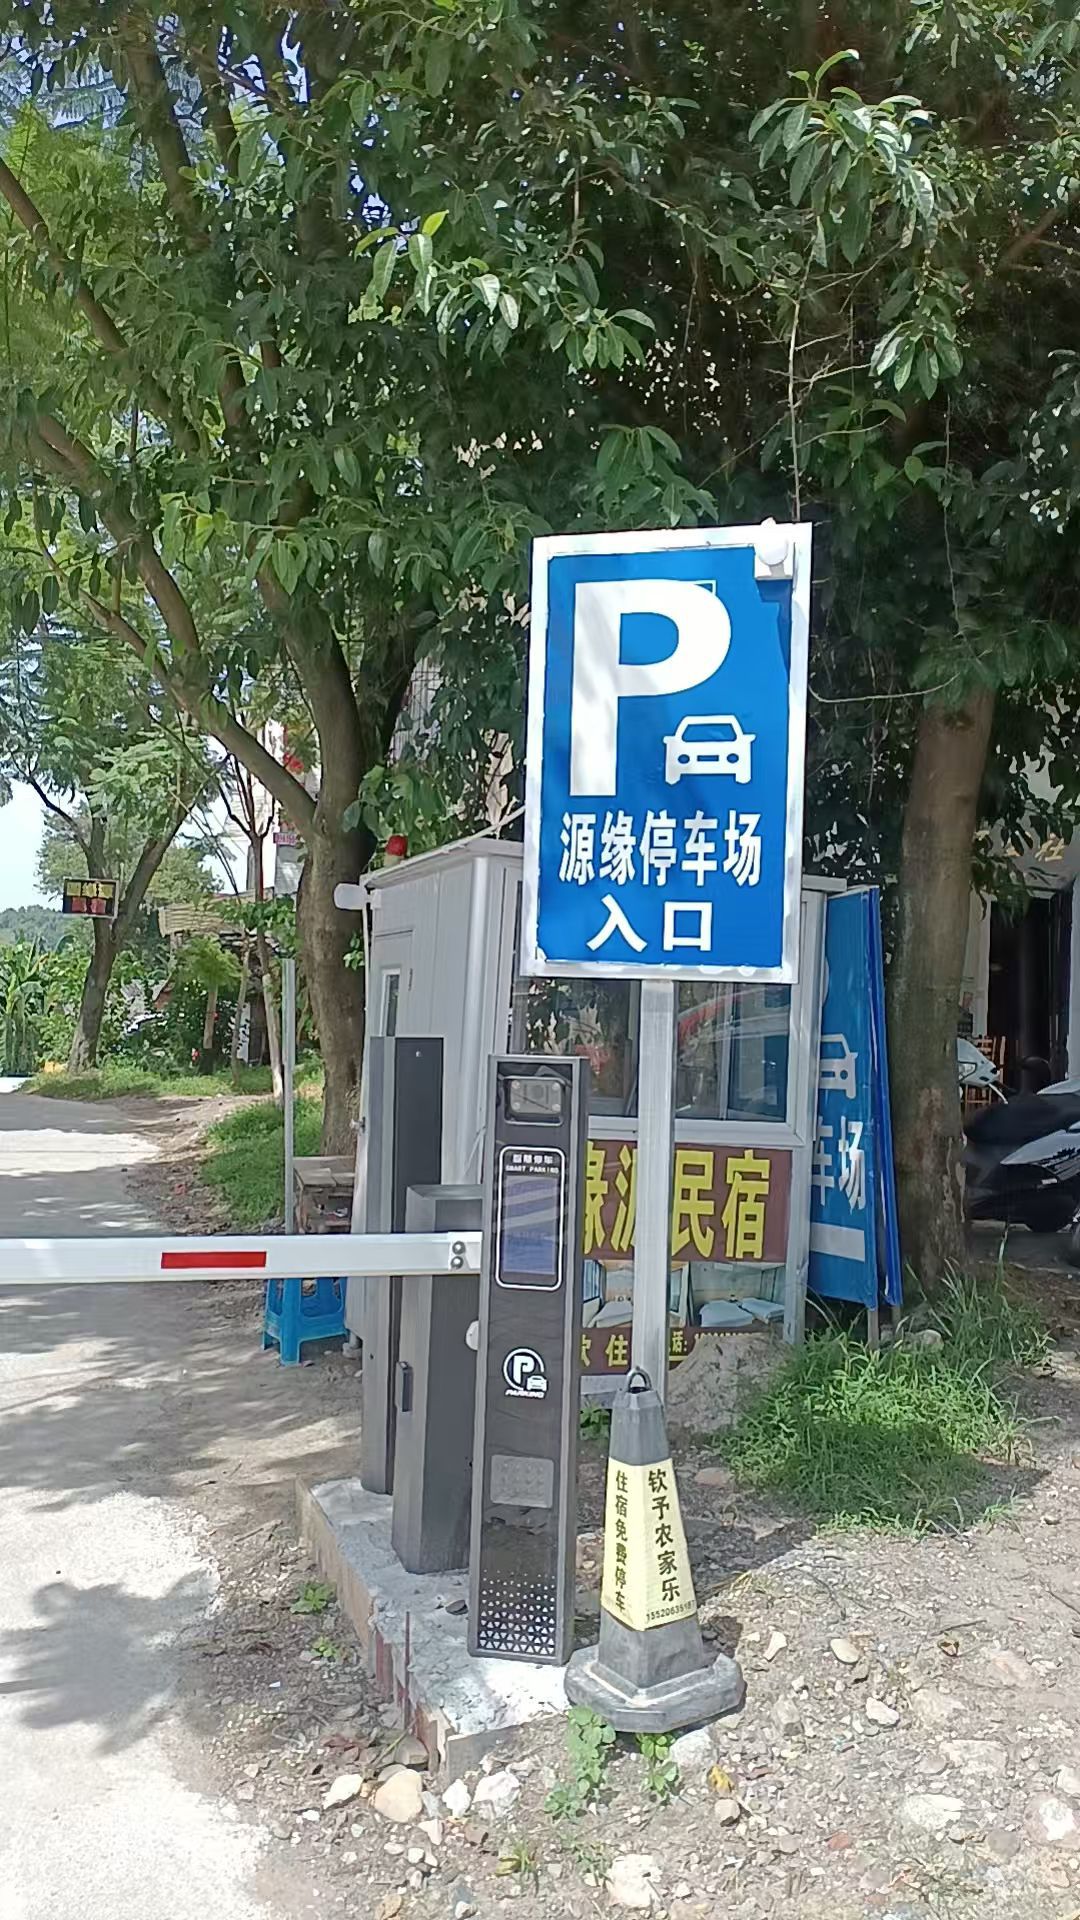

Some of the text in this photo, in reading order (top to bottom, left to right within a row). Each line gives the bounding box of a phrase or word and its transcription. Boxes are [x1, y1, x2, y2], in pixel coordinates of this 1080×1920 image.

[569, 581, 732, 797] P
[558, 809, 763, 888] 源缘停车场
[586, 893, 713, 954] 入口
[615, 1470, 629, 1613] 住宿免费停车
[648, 1468, 681, 1602] 钦予农家乐
